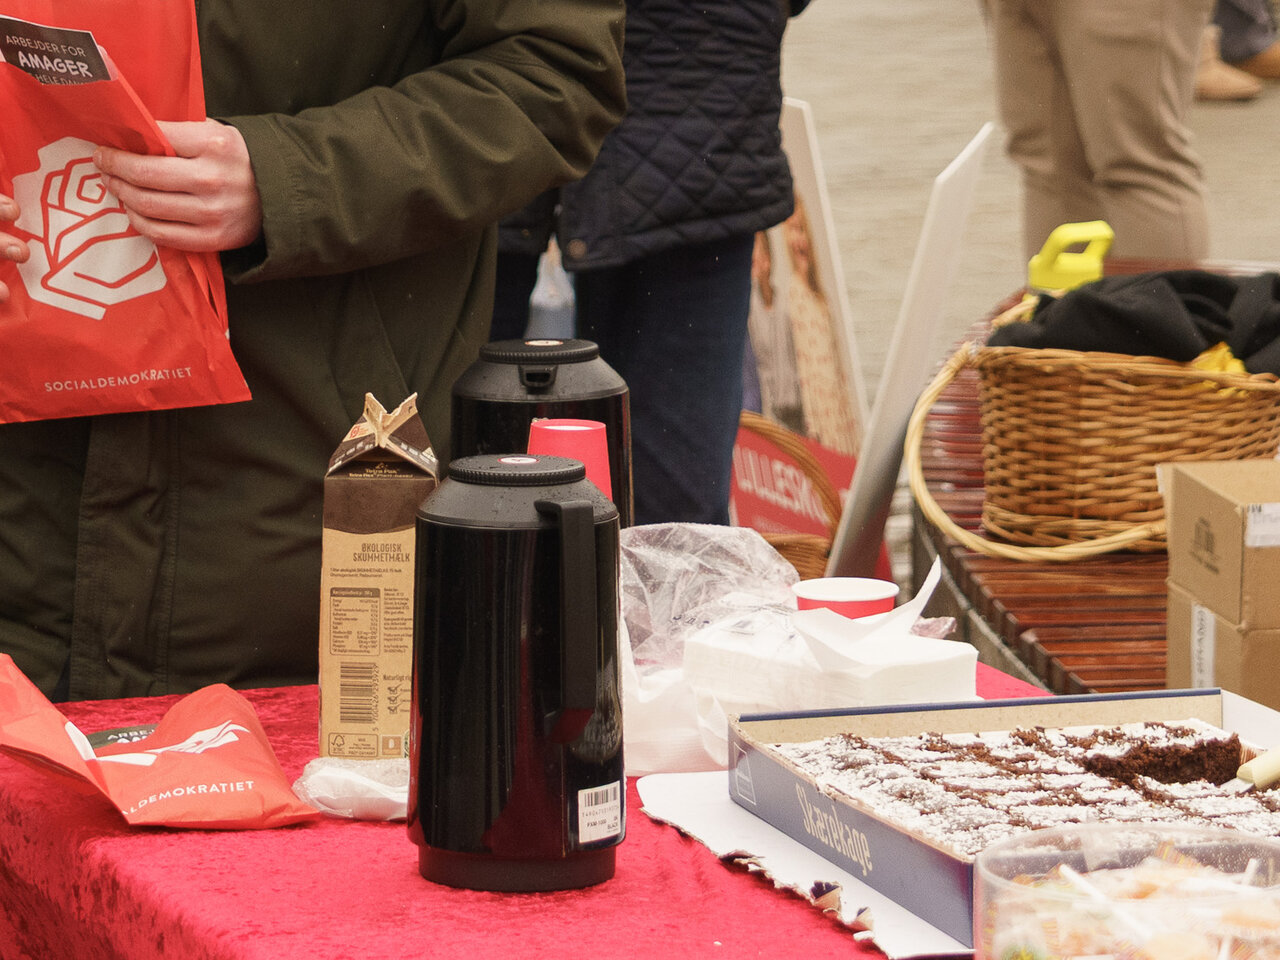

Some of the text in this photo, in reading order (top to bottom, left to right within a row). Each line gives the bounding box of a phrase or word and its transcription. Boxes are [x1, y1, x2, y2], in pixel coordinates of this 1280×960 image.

[6, 35, 86, 57] ARBEJDER FOR
[18, 50, 93, 78] AMAGER
[44, 367, 192, 392] SOCIALDEMOKRATIET
[353, 552, 410, 562] SKUMMETMÆLK
[361, 543, 402, 553] ØKOLOGISK
[795, 782, 873, 877] Skærekage
